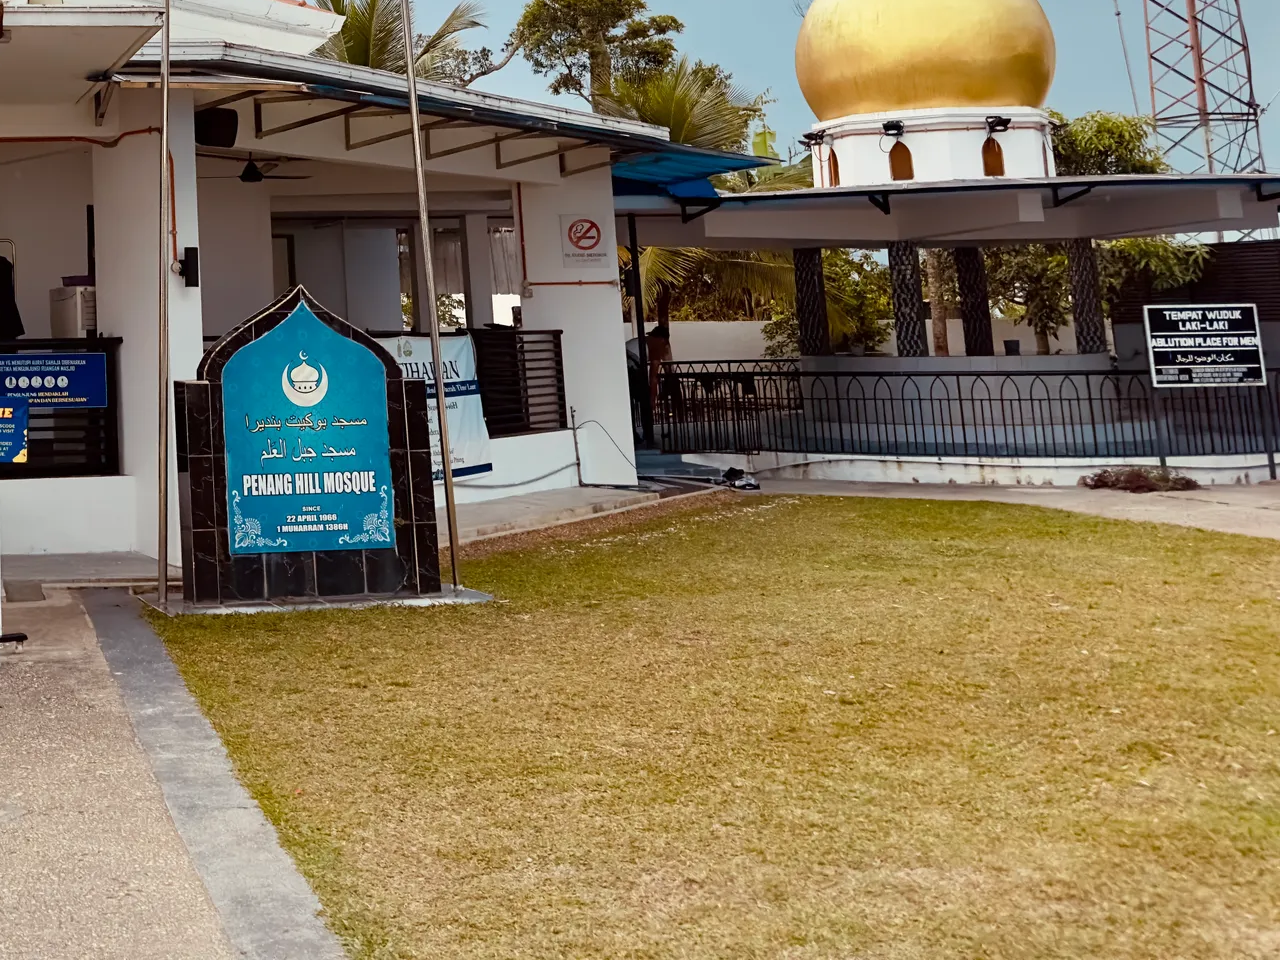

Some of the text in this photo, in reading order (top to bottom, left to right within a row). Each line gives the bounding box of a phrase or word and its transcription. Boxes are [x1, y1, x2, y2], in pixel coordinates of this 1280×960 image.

[1163, 310, 1241, 320] TEMPAT WUDUK
[1179, 321, 1228, 330] LAKI-LAKI
[1152, 336, 1258, 347] ABLUTION PLACE FOR MEN
[245, 413, 367, 433] مسجد بوكيت بنديرا
[292, 438, 317, 463] جبل
[321, 443, 356, 463] مسجد
[243, 471, 376, 497] PENANG HILL MOSQUE
[286, 515, 296, 523] 22
[297, 514, 318, 522] APRIL
[282, 524, 324, 532] MUHARRAM
[326, 523, 348, 531] 1386H
